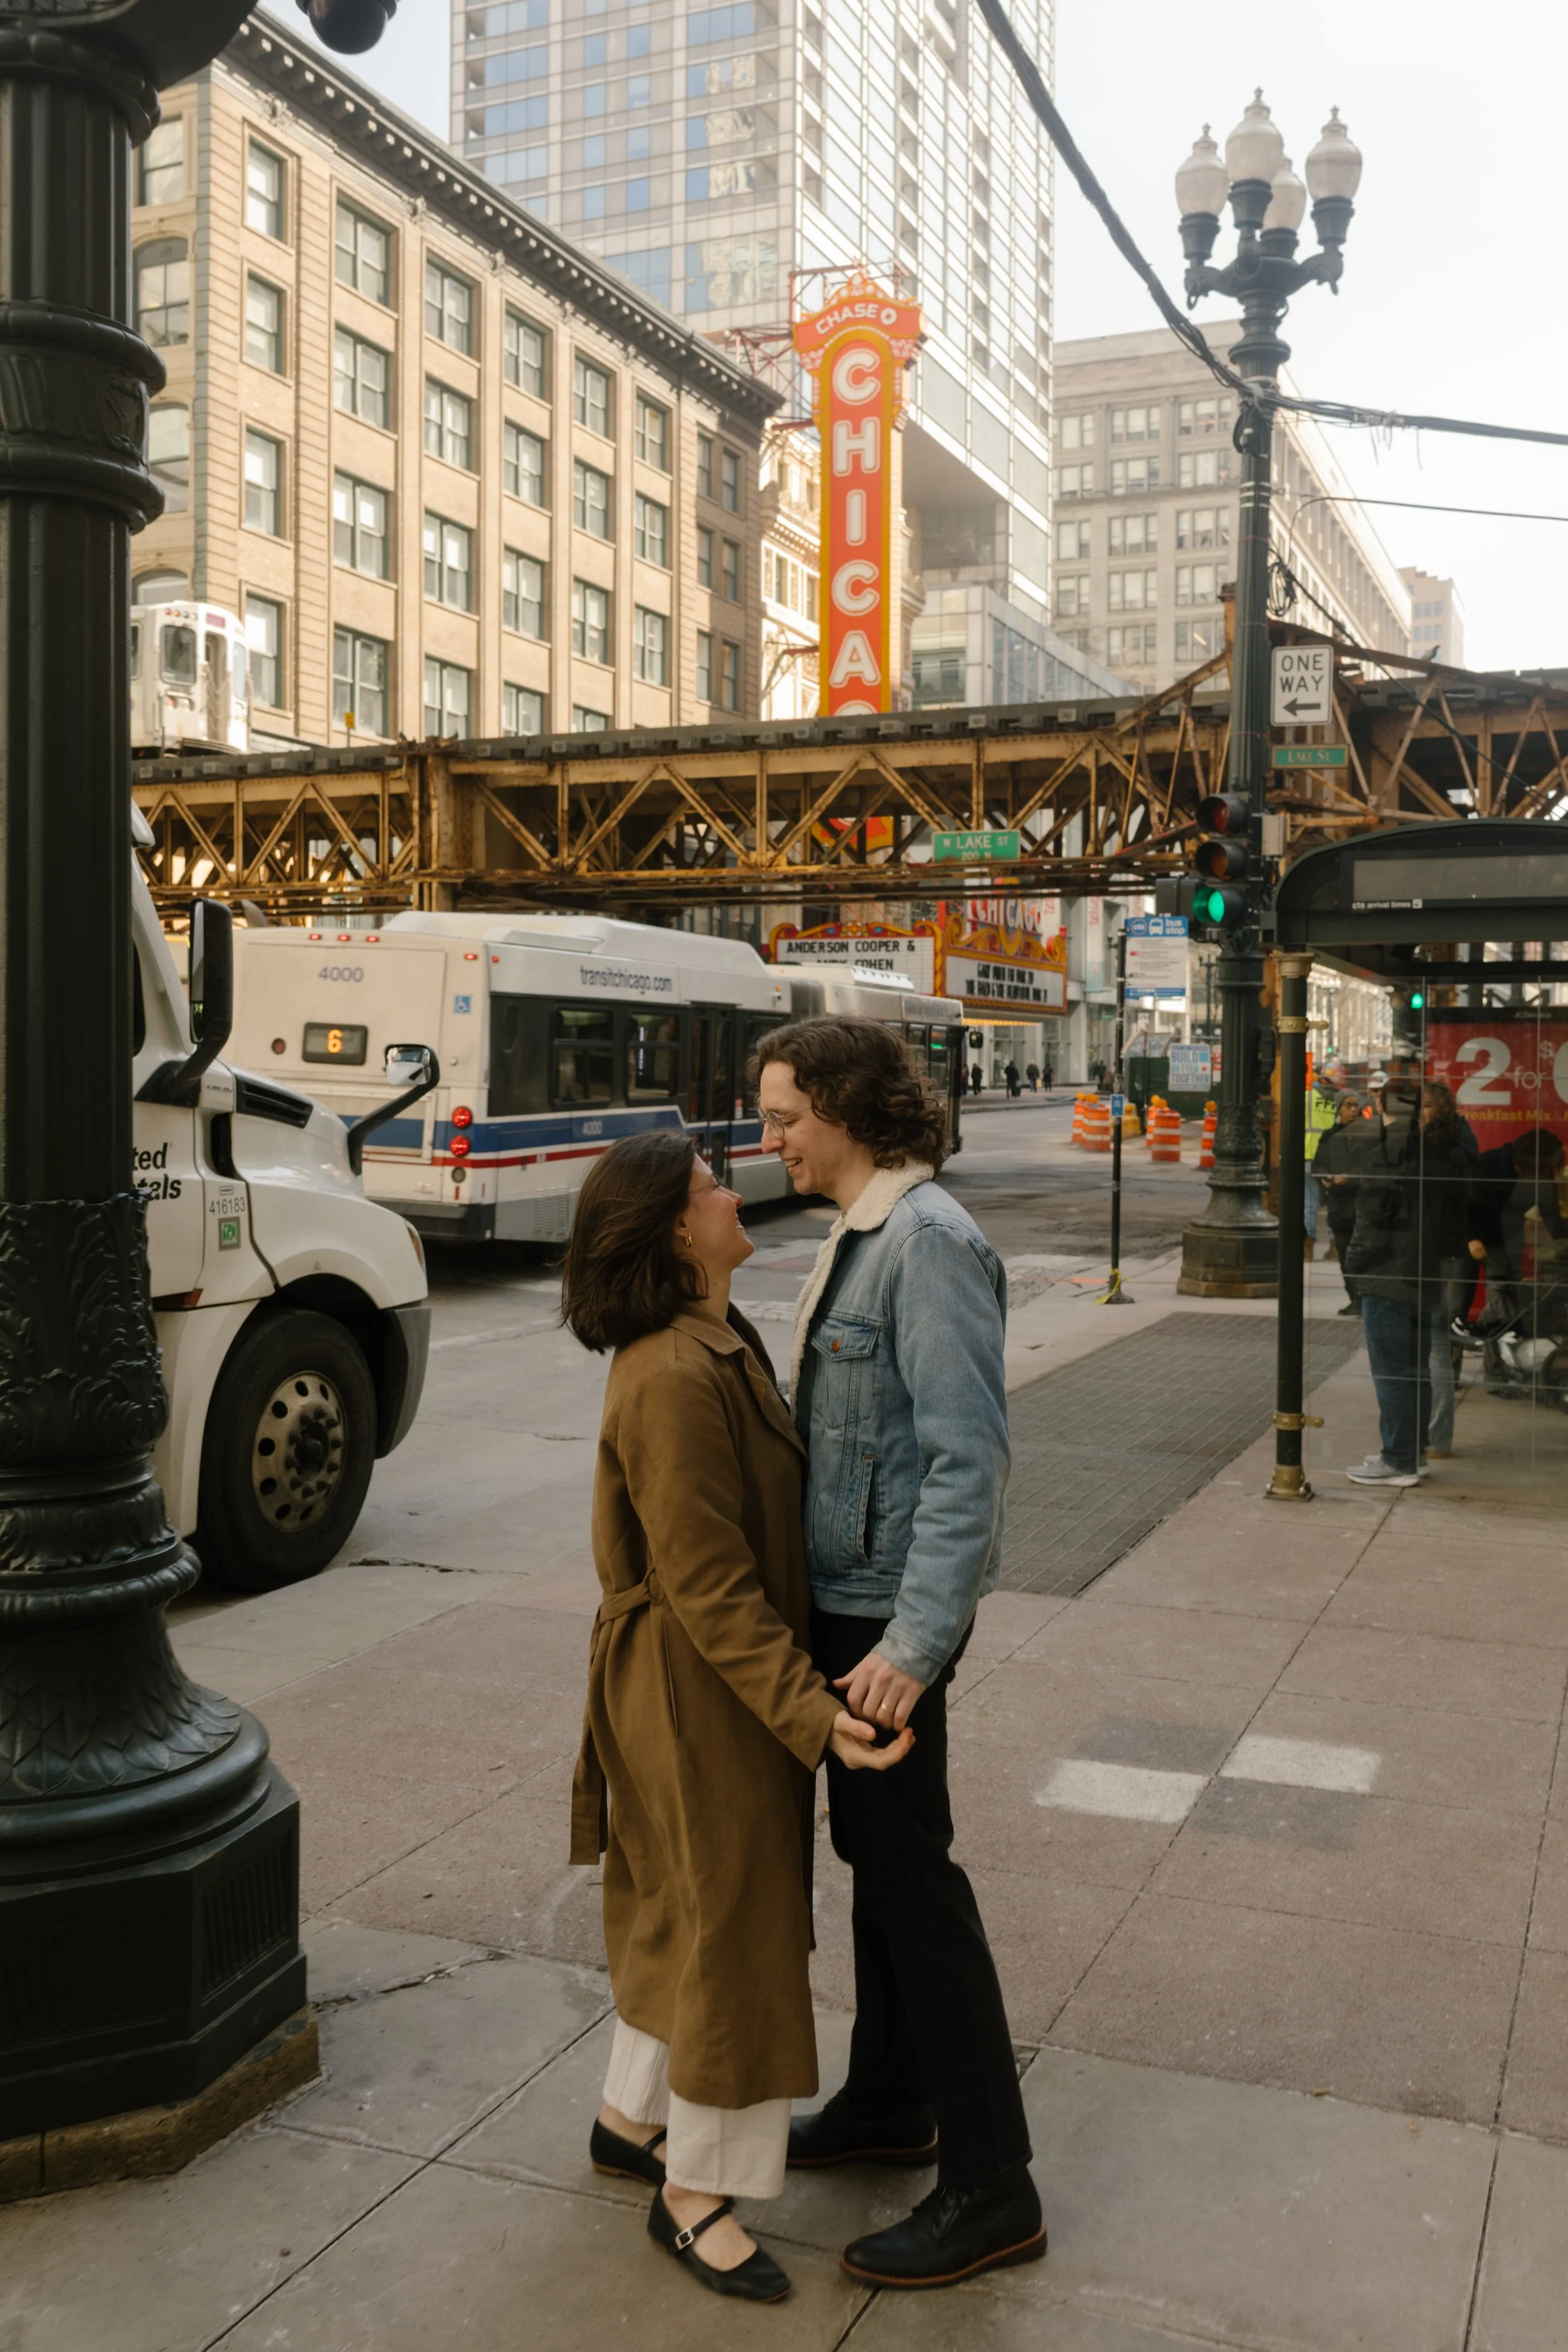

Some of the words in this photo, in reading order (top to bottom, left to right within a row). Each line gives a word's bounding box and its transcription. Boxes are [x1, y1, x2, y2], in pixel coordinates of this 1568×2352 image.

[815, 303, 879, 334] CHASE
[829, 347, 882, 716] CHICA
[1281, 654, 1324, 672] ONE
[1280, 675, 1324, 693] WAY
[943, 838, 951, 847] W
[956, 835, 992, 849] LAKE
[997, 836, 1009, 846] ST
[961, 851, 980, 861] 200
[1165, 918, 1182, 927] bus
[1165, 926, 1186, 935] stop
[787, 941, 849, 953] ANDERSON
[855, 941, 900, 952] COOPER
[907, 940, 915, 951] &
[318, 967, 364, 982] 4000
[580, 966, 673, 995] transitchicago.com
[327, 1029, 343, 1054] 6
[1172, 1051, 1198, 1062] BUILD
[1456, 1037, 1512, 1106] 2
[1513, 1066, 1547, 1089] for
[583, 1120, 603, 1135] 4000
[209, 1197, 246, 1215] 416183
